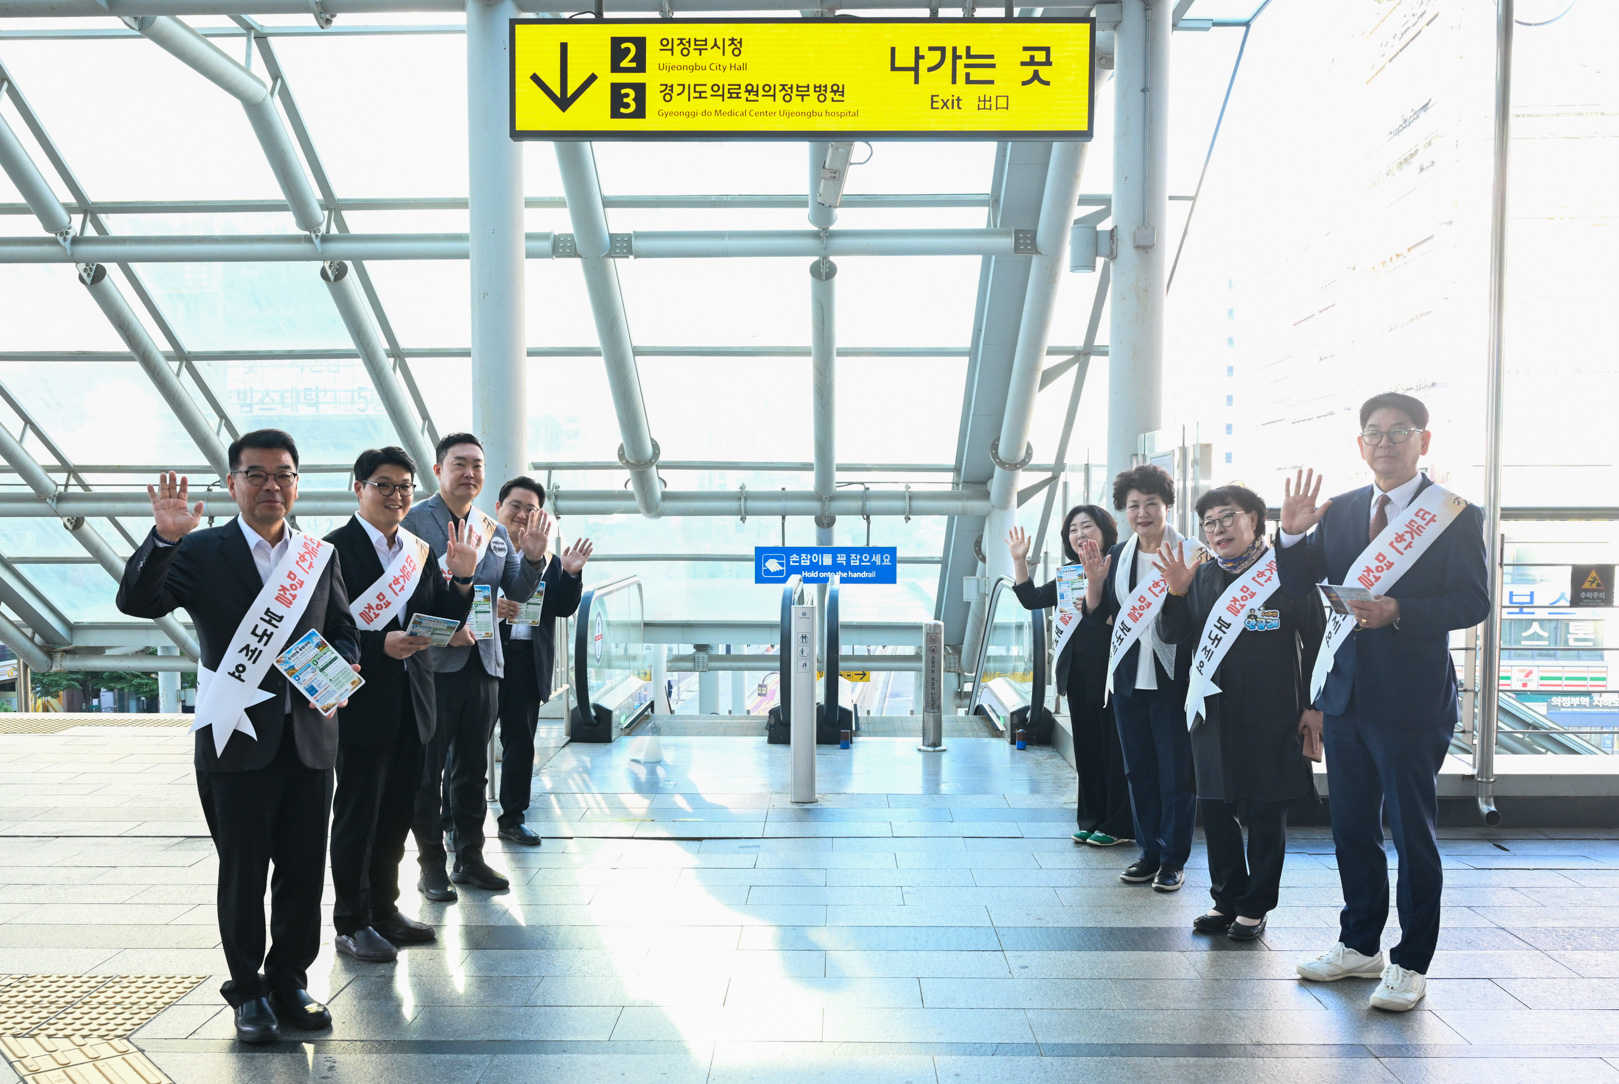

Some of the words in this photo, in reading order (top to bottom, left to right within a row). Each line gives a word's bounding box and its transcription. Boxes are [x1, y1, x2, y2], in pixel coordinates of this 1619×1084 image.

[619, 42, 637, 68] 2
[659, 36, 743, 57] 의정부시청
[658, 62, 707, 73] Uijeongbu
[709, 62, 727, 73] City
[729, 62, 748, 71] Hall
[890, 45, 996, 85] 나가는
[1020, 46, 1053, 86] 곳
[619, 88, 637, 114] 3
[659, 83, 845, 103] 경기도의료원의정부병원
[930, 94, 962, 110] Exit
[977, 94, 1009, 111] 出口
[657, 109, 713, 118] Gyeonggi-do
[714, 109, 747, 117] Medical
[779, 110, 823, 119] Uijeongbu
[825, 109, 859, 118] hospital
[1389, 508, 1437, 555] 따뜻한
[790, 553, 832, 566] 손잡이를
[836, 554, 846, 566] 꼭
[850, 554, 891, 566] 잡으세요
[1358, 552, 1394, 590] 명절
[388, 554, 417, 597] 따뜻한
[802, 570, 818, 578] Hold
[836, 570, 848, 578] the
[848, 570, 876, 578] handrail
[1252, 560, 1278, 587] 뜻한
[275, 570, 304, 608] 명절
[1226, 585, 1257, 617] 명절
[359, 592, 392, 625] 명절
[1128, 595, 1152, 623] 명절
[228, 607, 284, 682] 보내세요
[1196, 616, 1232, 676] 보내세요
[1551, 696, 1590, 707] 의정부역
